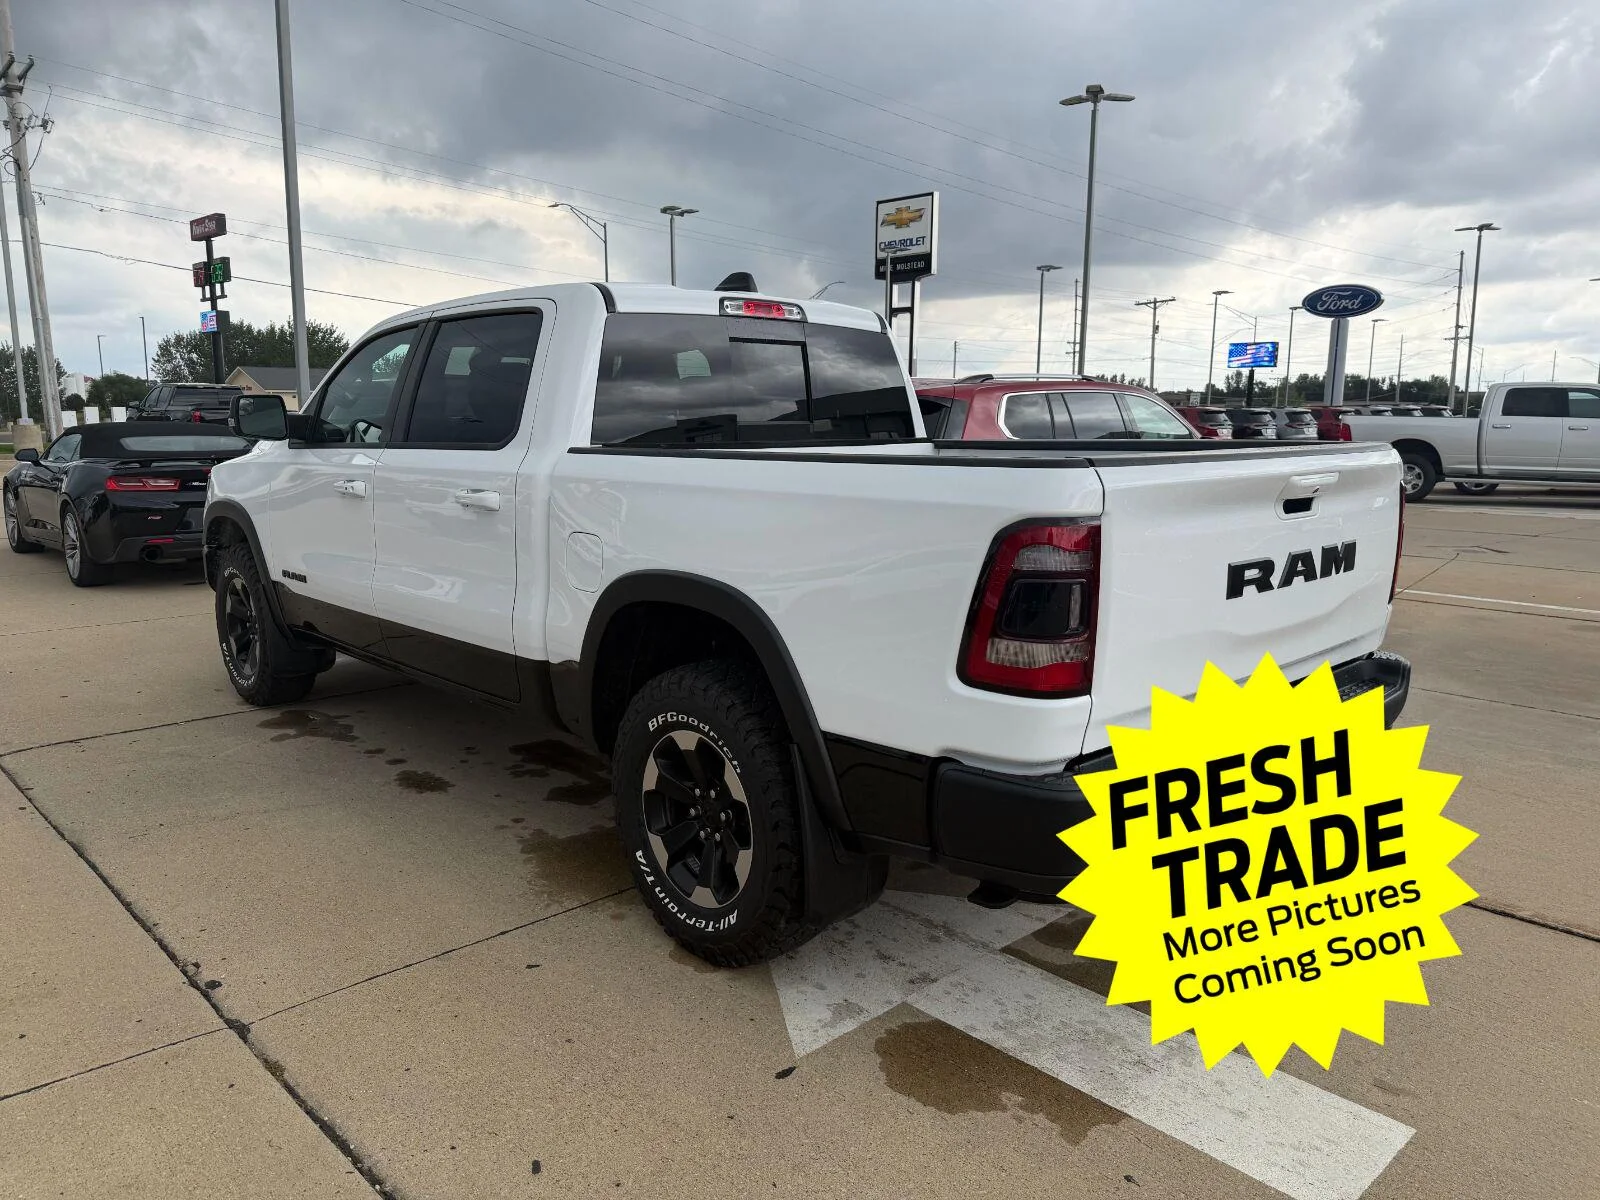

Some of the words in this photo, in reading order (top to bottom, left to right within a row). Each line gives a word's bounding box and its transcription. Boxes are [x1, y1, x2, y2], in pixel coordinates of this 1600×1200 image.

[879, 236, 926, 251] CHEVROLET
[880, 264, 893, 272] MIE
[897, 261, 925, 271] MOLSTEAD
[1317, 289, 1363, 311] Ford
[1226, 539, 1356, 600] RAM
[647, 711, 742, 774] BFGoodrich
[635, 850, 656, 886] T/A
[654, 886, 738, 932] All-Terrain
